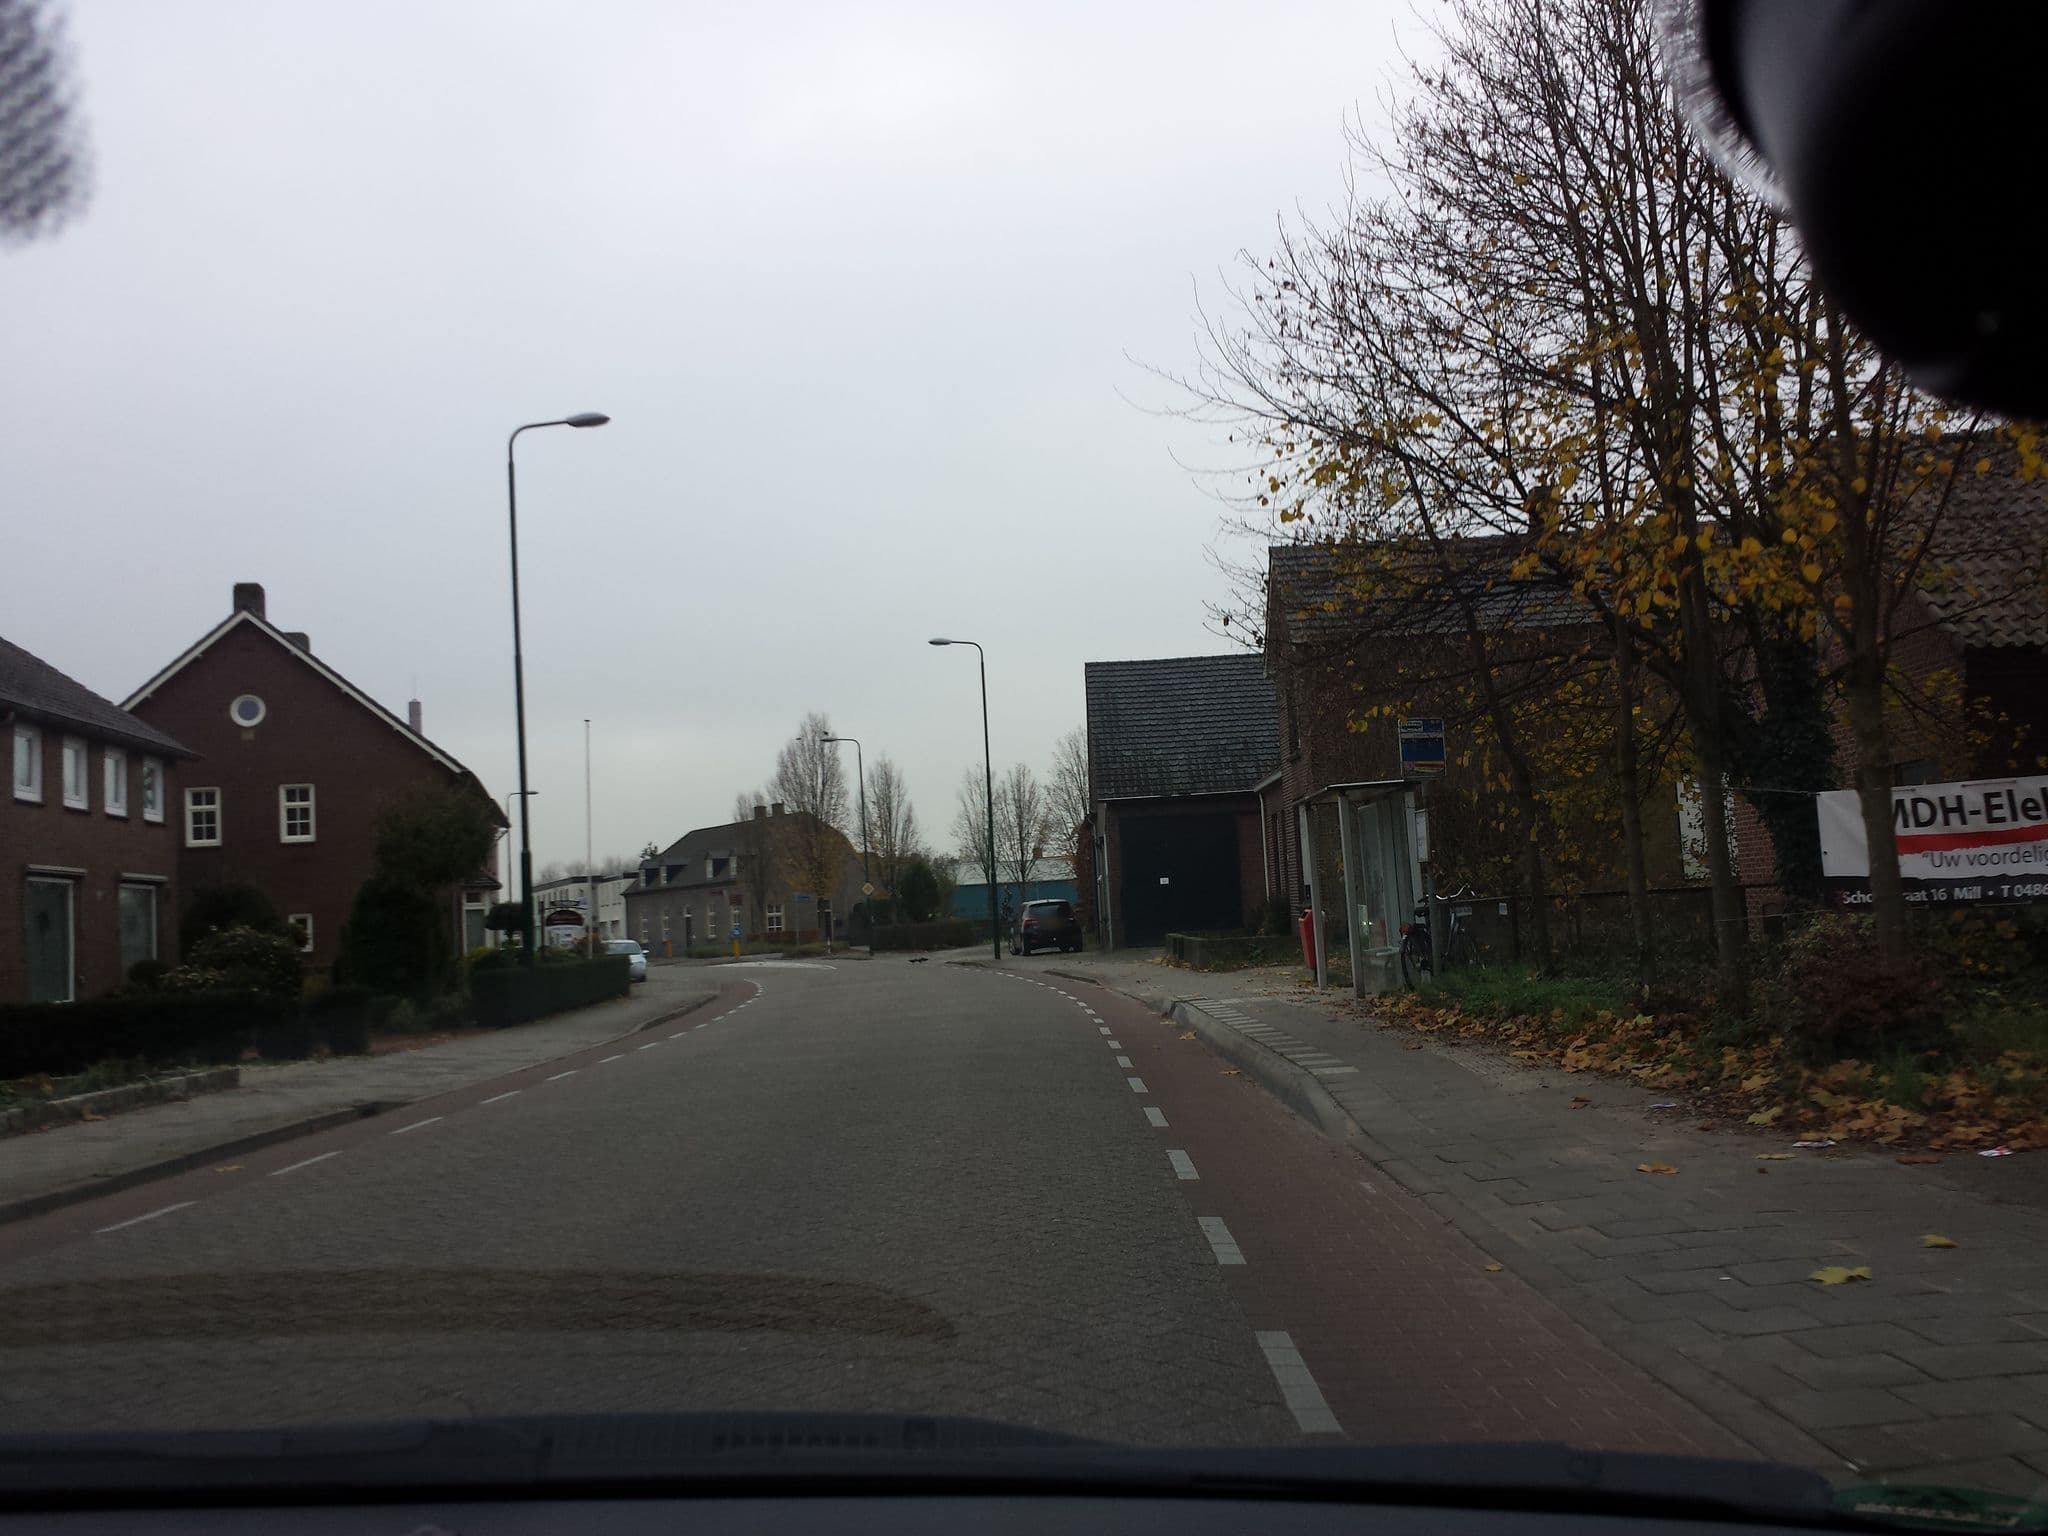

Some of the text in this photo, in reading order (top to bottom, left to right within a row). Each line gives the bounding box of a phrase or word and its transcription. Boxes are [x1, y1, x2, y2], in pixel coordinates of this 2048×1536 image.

[1930, 888, 1948, 901] 16
[1953, 885, 1982, 900] Mill
[2000, 885, 2011, 898] T
